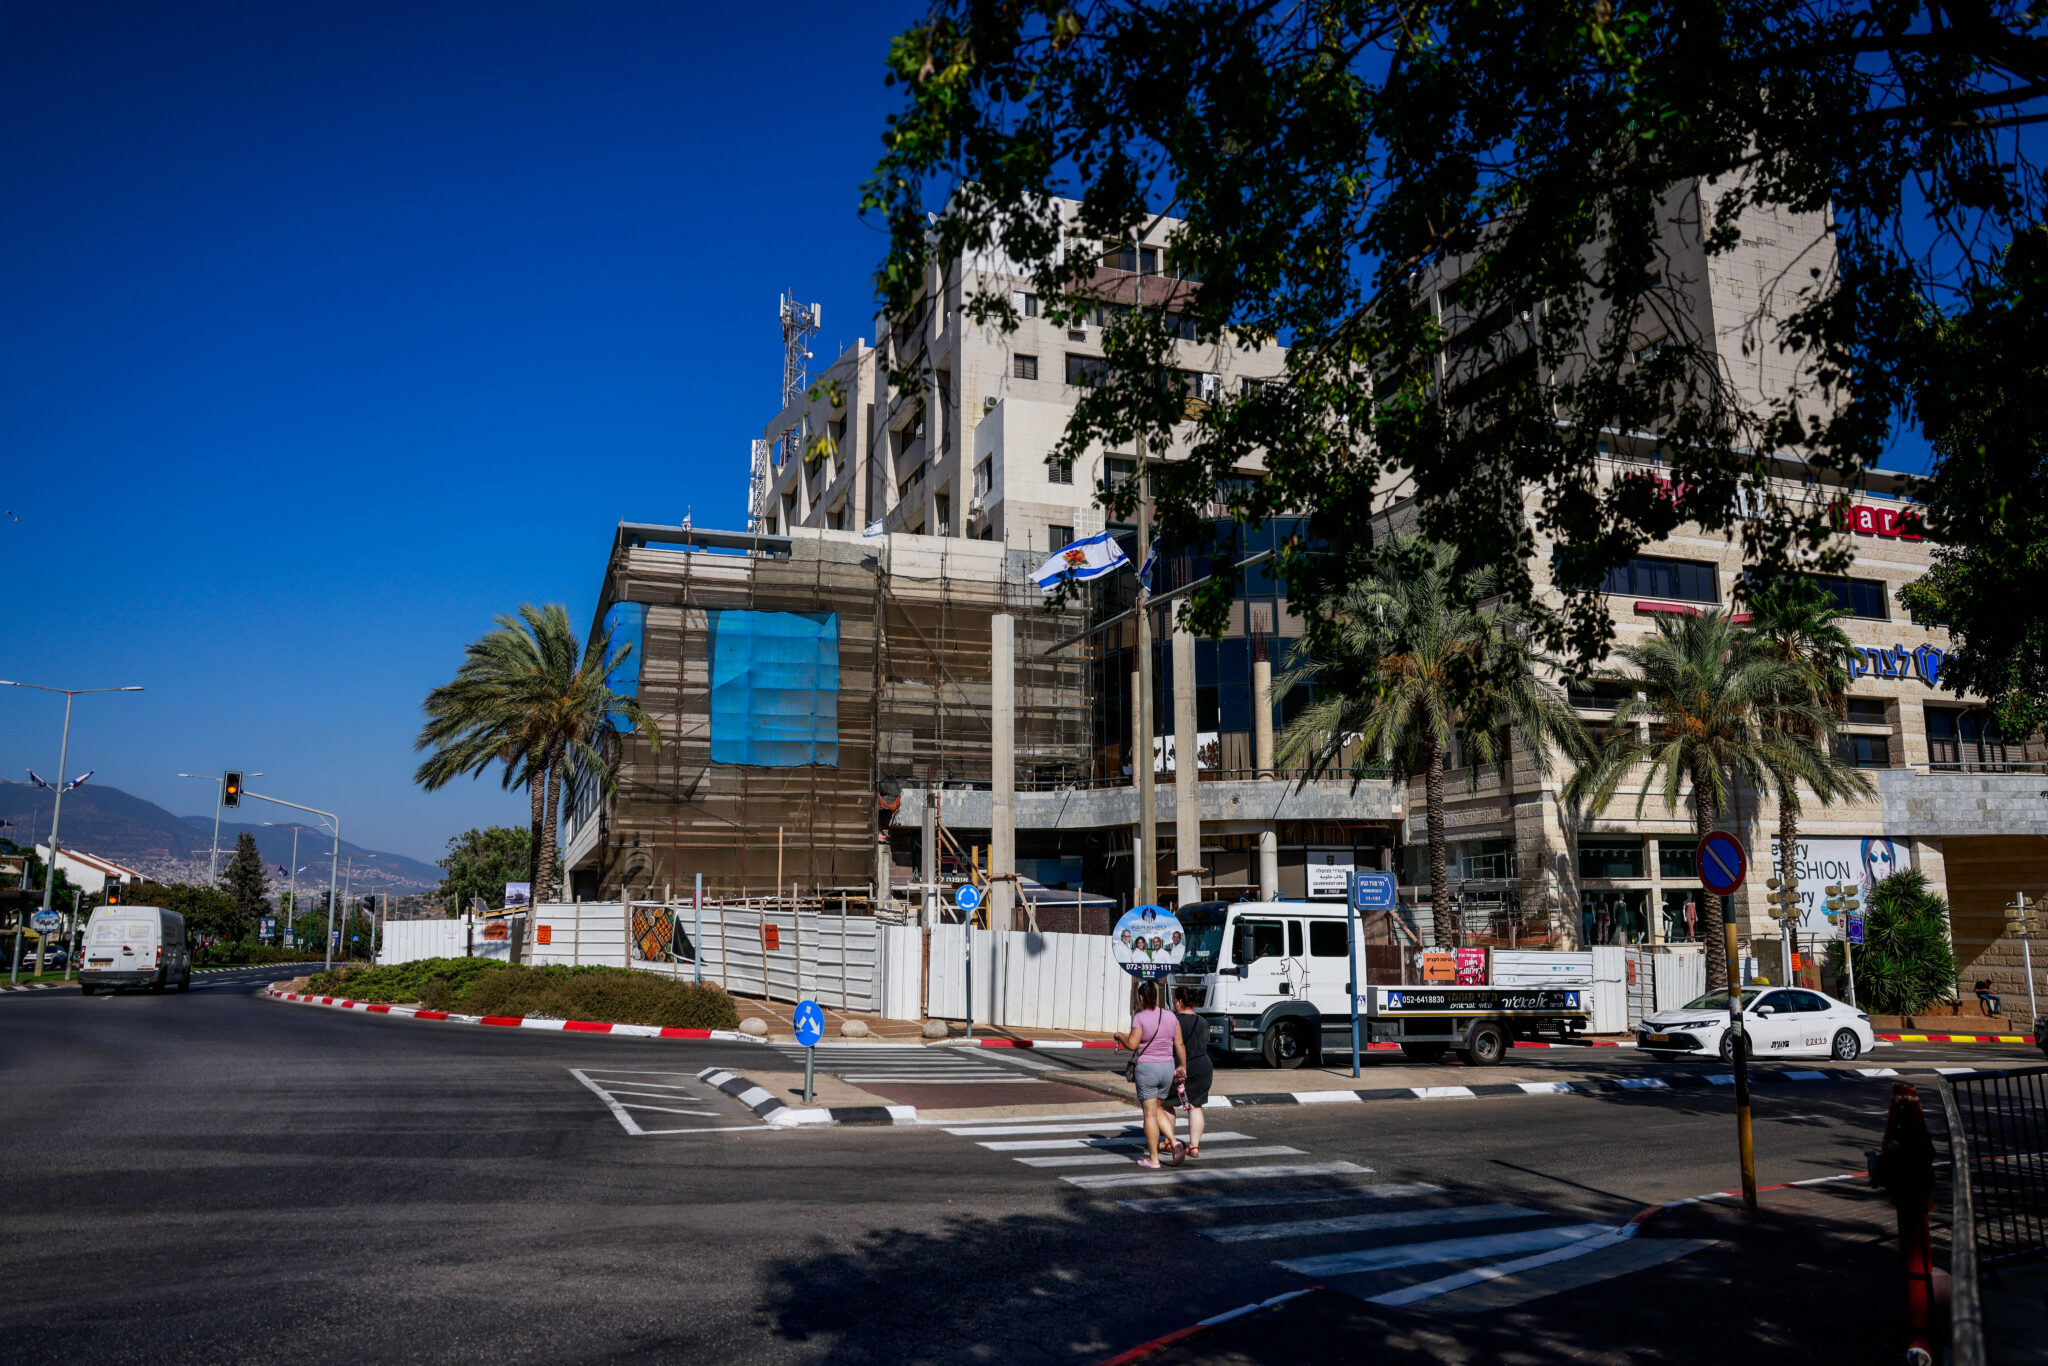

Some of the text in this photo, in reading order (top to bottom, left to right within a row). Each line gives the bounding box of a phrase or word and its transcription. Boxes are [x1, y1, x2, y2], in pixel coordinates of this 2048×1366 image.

[1847, 643, 1910, 680] לצרכן
[1771, 843, 1809, 860] ery
[1773, 861, 1851, 880] FSHION
[1126, 963, 1172, 971] 072-3939-111
[1402, 995, 1445, 1004] 052-6418830
